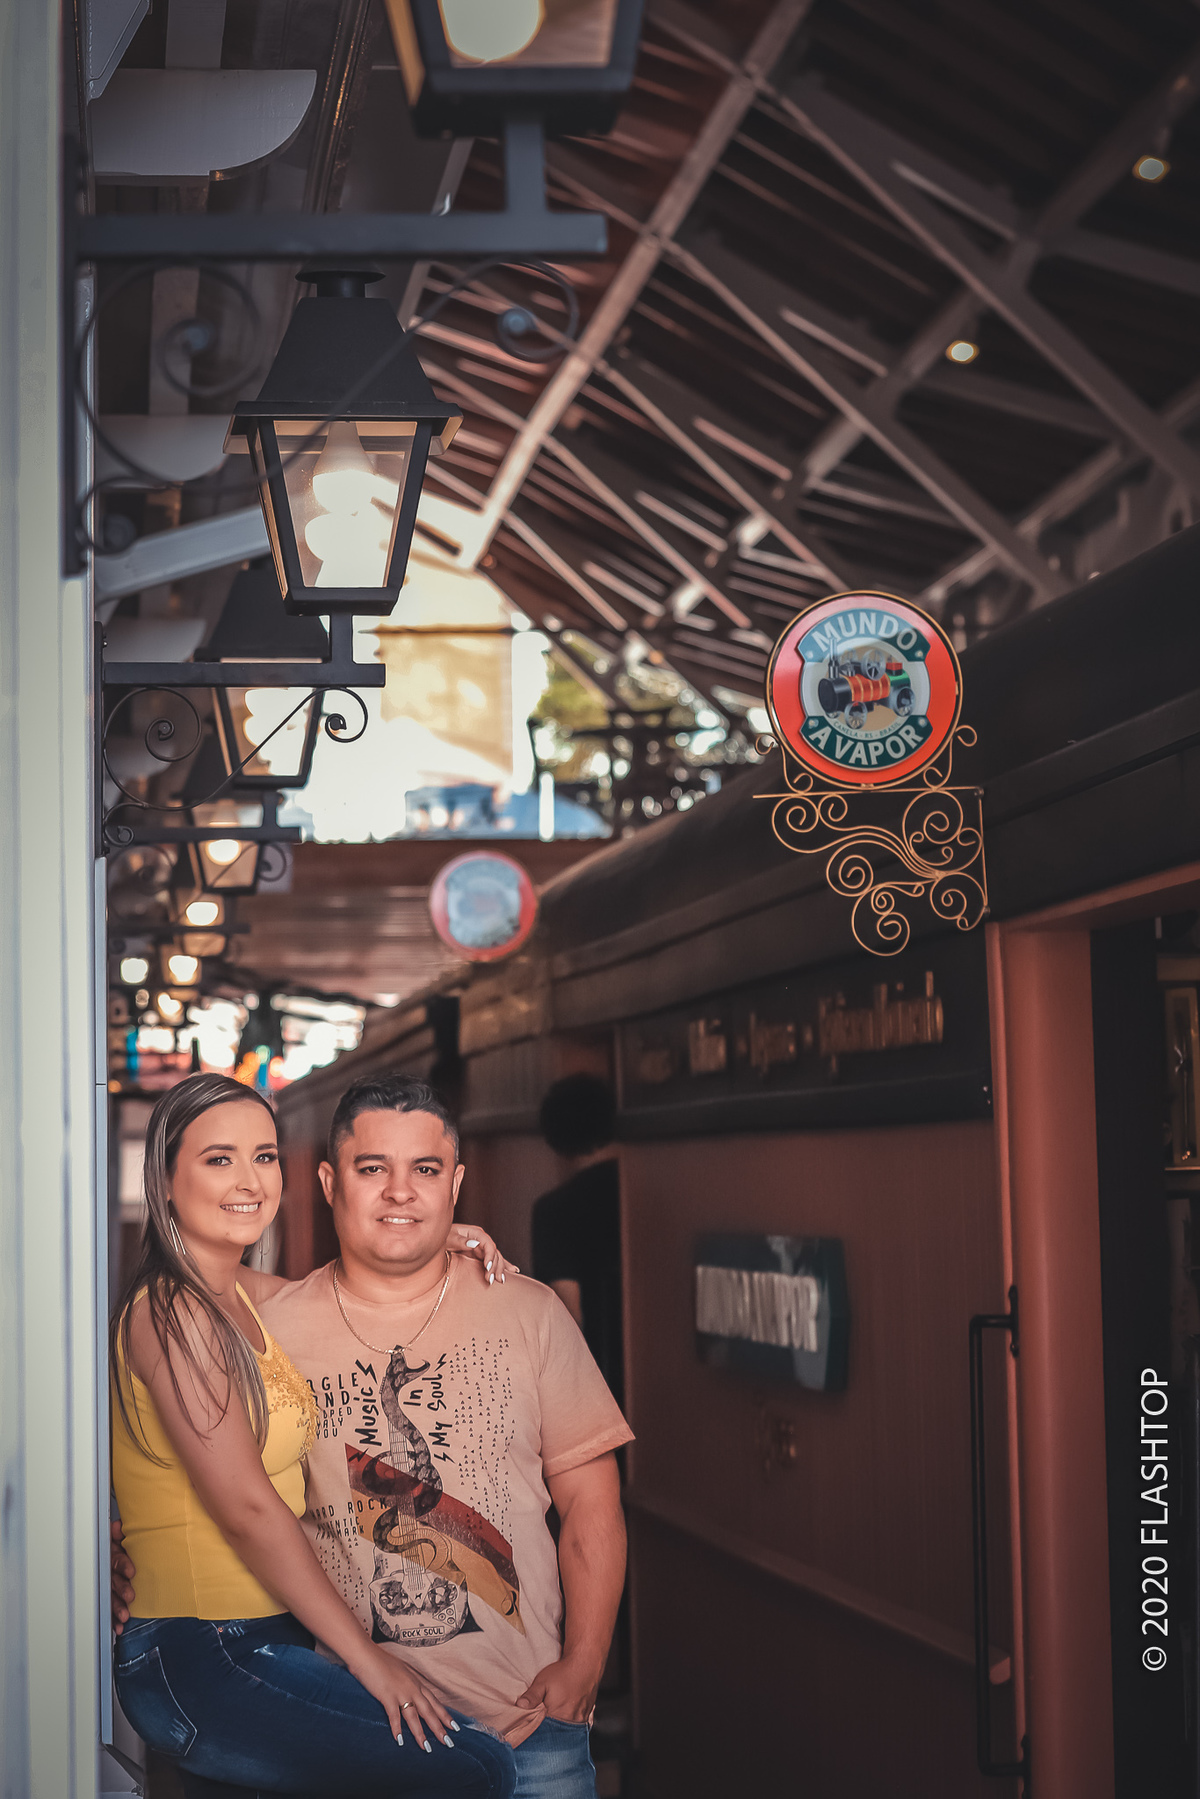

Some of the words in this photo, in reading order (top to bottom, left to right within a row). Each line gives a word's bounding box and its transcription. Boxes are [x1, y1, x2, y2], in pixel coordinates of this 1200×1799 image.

[811, 612, 918, 652] MUNDO
[833, 721, 858, 738] CANELA
[809, 725, 832, 746] A
[835, 724, 924, 766] VAPOR
[403, 1389, 423, 1407] In
[422, 1373, 447, 1411] Soul
[353, 1386, 382, 1447] Music
[428, 1421, 453, 1447] My
[347, 1496, 388, 1514] ROCK
[402, 1629, 421, 1638] ROCK
[424, 1628, 443, 1636] SOUL
